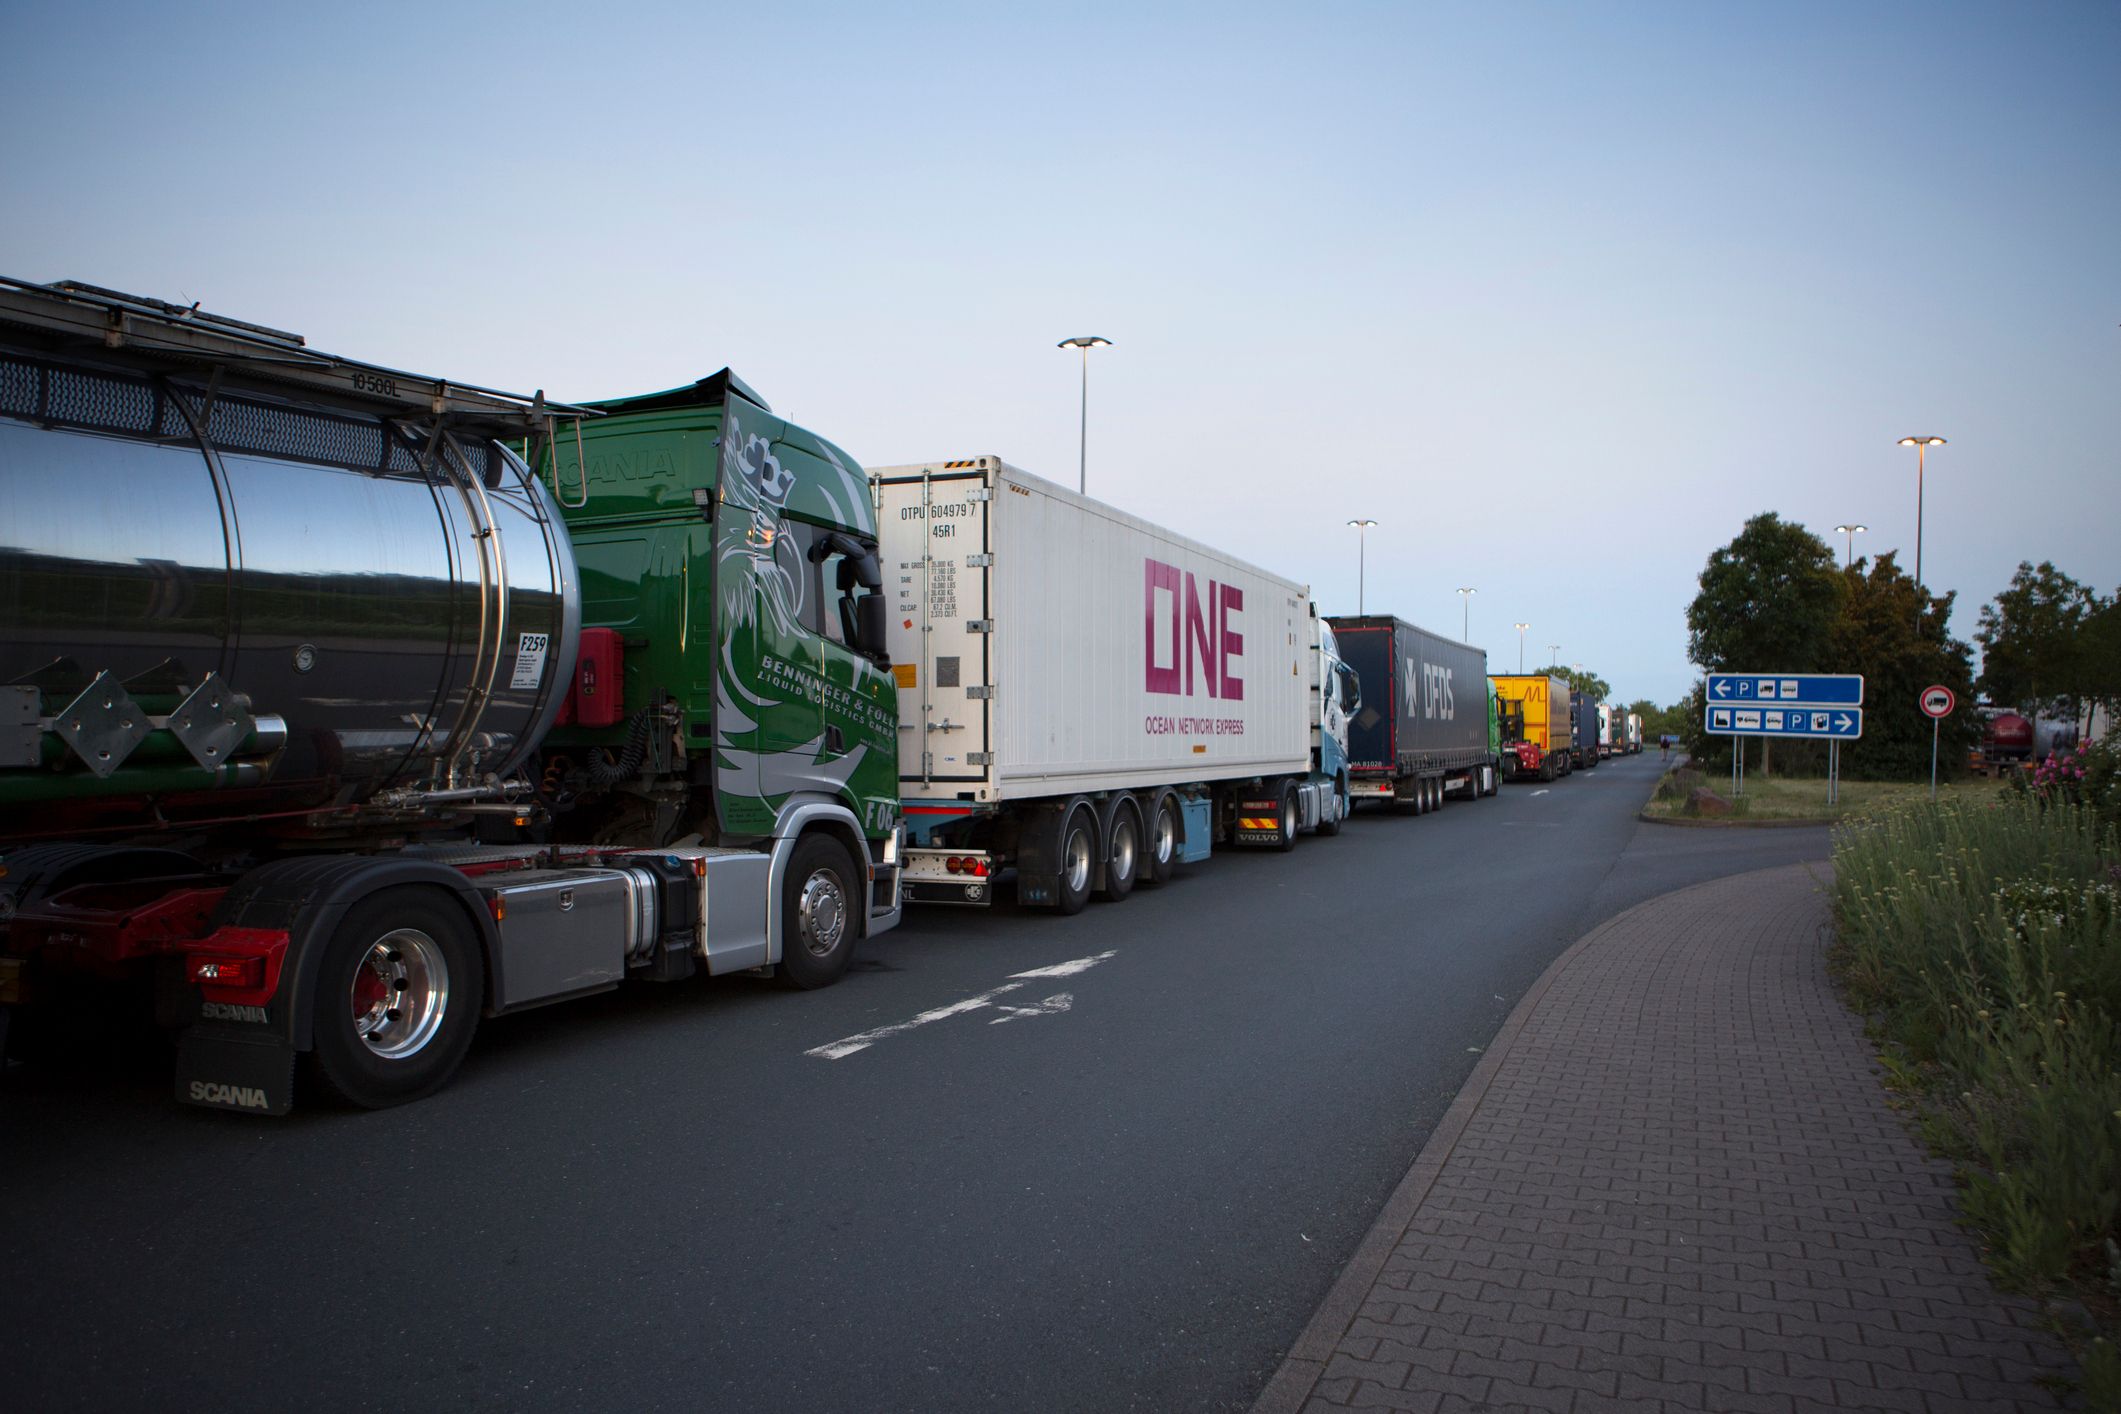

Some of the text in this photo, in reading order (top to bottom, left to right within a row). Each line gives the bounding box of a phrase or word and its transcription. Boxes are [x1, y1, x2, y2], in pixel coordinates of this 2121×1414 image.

[901, 503, 976, 520] OTPU 604979 7
[933, 524, 956, 538] 45R1
[911, 561, 925, 569] GROSS
[900, 590, 910, 598] NET
[1145, 557, 1243, 701] ONE
[520, 636, 547, 652] F259
[762, 655, 850, 705] BENNINGER
[854, 699, 864, 712] &
[1423, 662, 1454, 721] DFDS
[1740, 682, 1749, 695] P
[757, 671, 803, 695] LIQUID
[808, 692, 865, 724] LOGISTICS
[1145, 716, 1244, 735] OCEAN NETWORK EXPRESS
[1792, 714, 1801, 728] P
[865, 801, 894, 832] F 06
[1239, 834, 1279, 842] VOLVO
[202, 1002, 268, 1024] SCANIA
[190, 1081, 269, 1109] SCANIA
